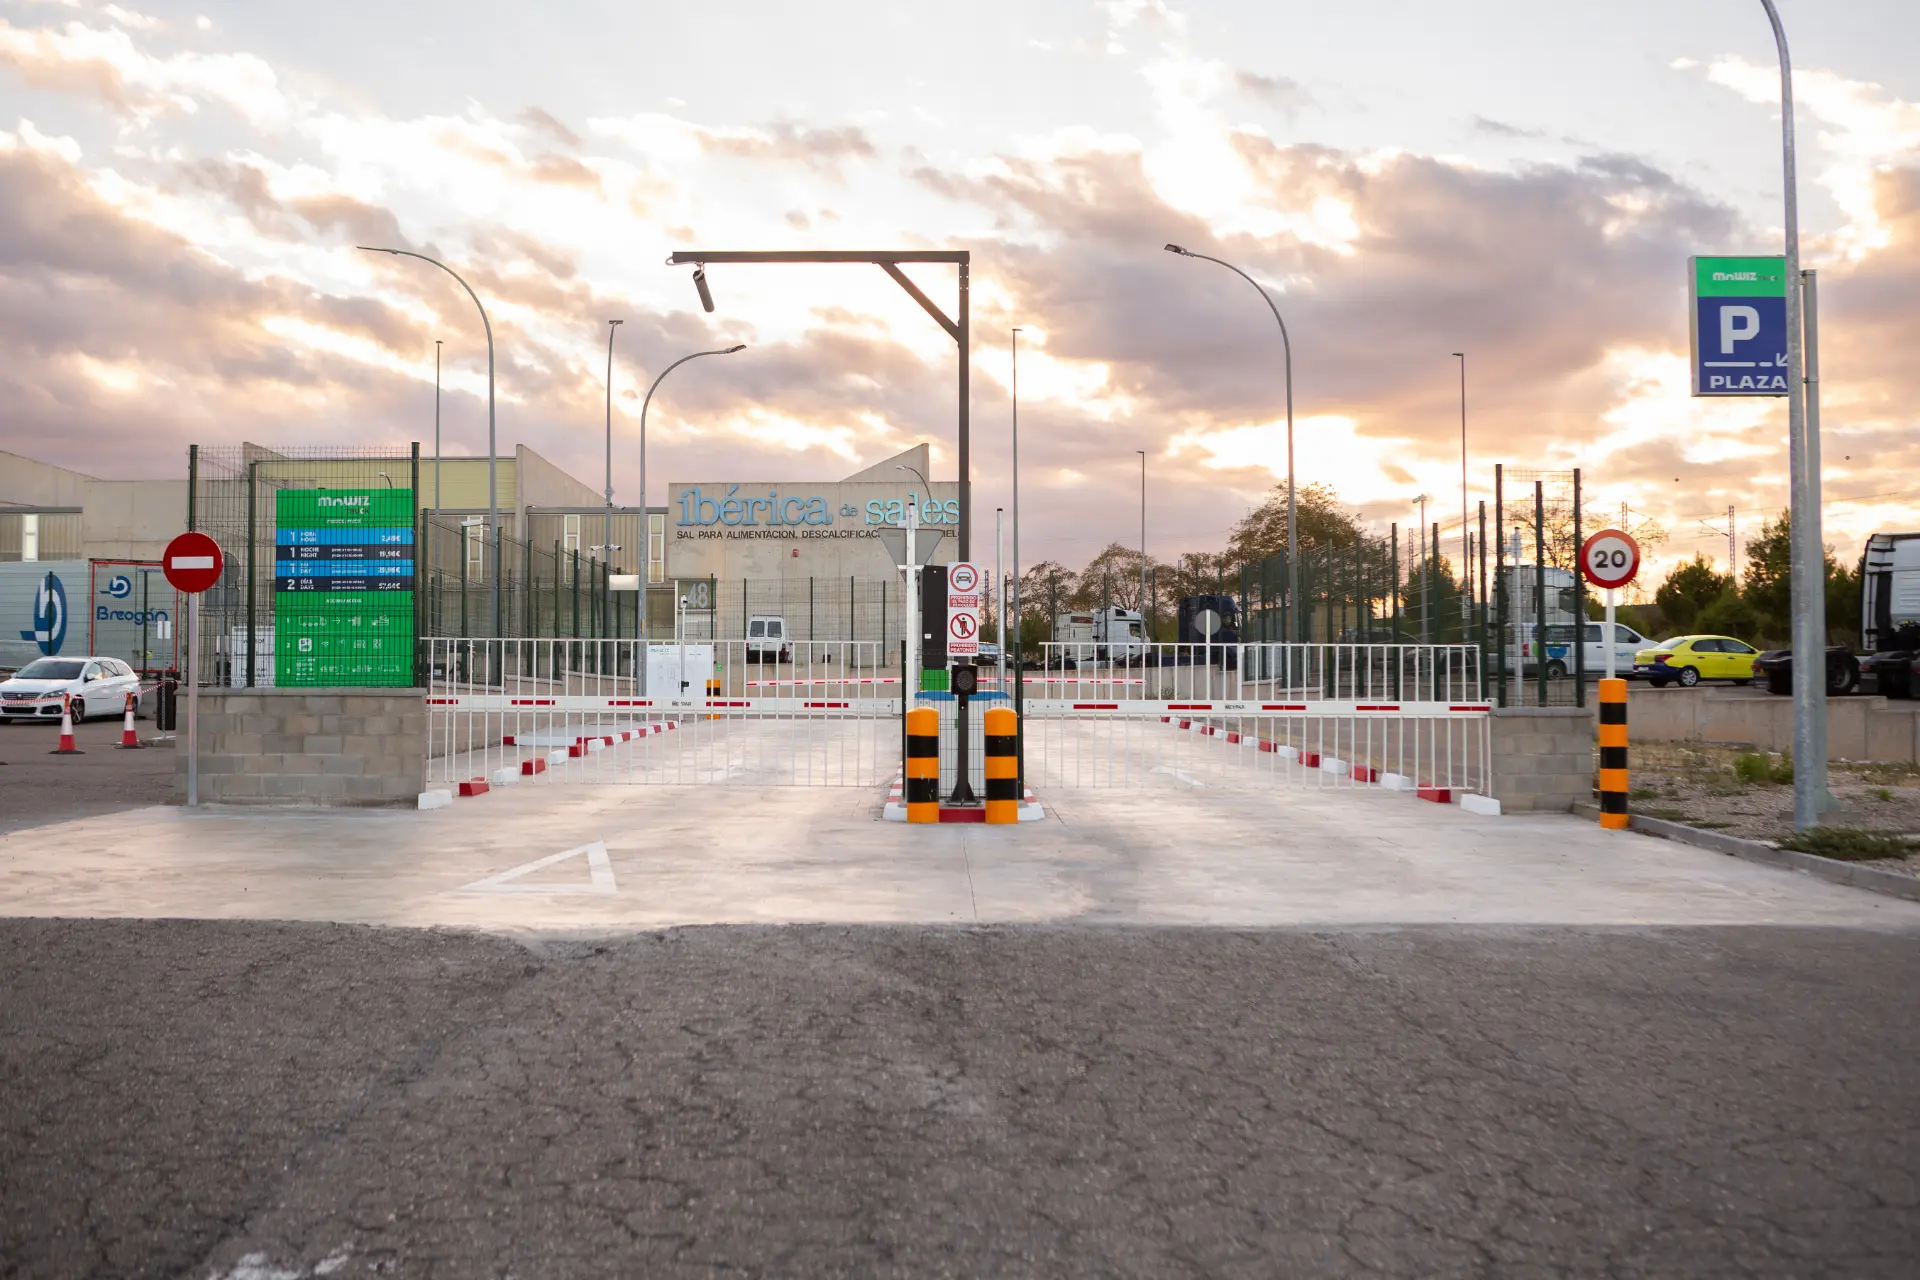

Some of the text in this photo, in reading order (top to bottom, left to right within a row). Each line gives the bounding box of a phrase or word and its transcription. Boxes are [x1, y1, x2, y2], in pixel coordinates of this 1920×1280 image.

[1720, 305, 1760, 354] P
[1709, 375, 1788, 389] PLAZA
[676, 484, 833, 526] ibérica
[839, 503, 858, 517] de
[676, 530, 695, 539] SAL
[698, 530, 723, 539] PARA
[726, 530, 798, 540] ALIMENTACION,
[801, 529, 881, 539] DESCALCIFICAC
[289, 546, 295, 558] 1
[1594, 549, 1626, 569] 20
[289, 563, 295, 574] 1
[287, 579, 296, 590] 2
[686, 582, 708, 608] 48
